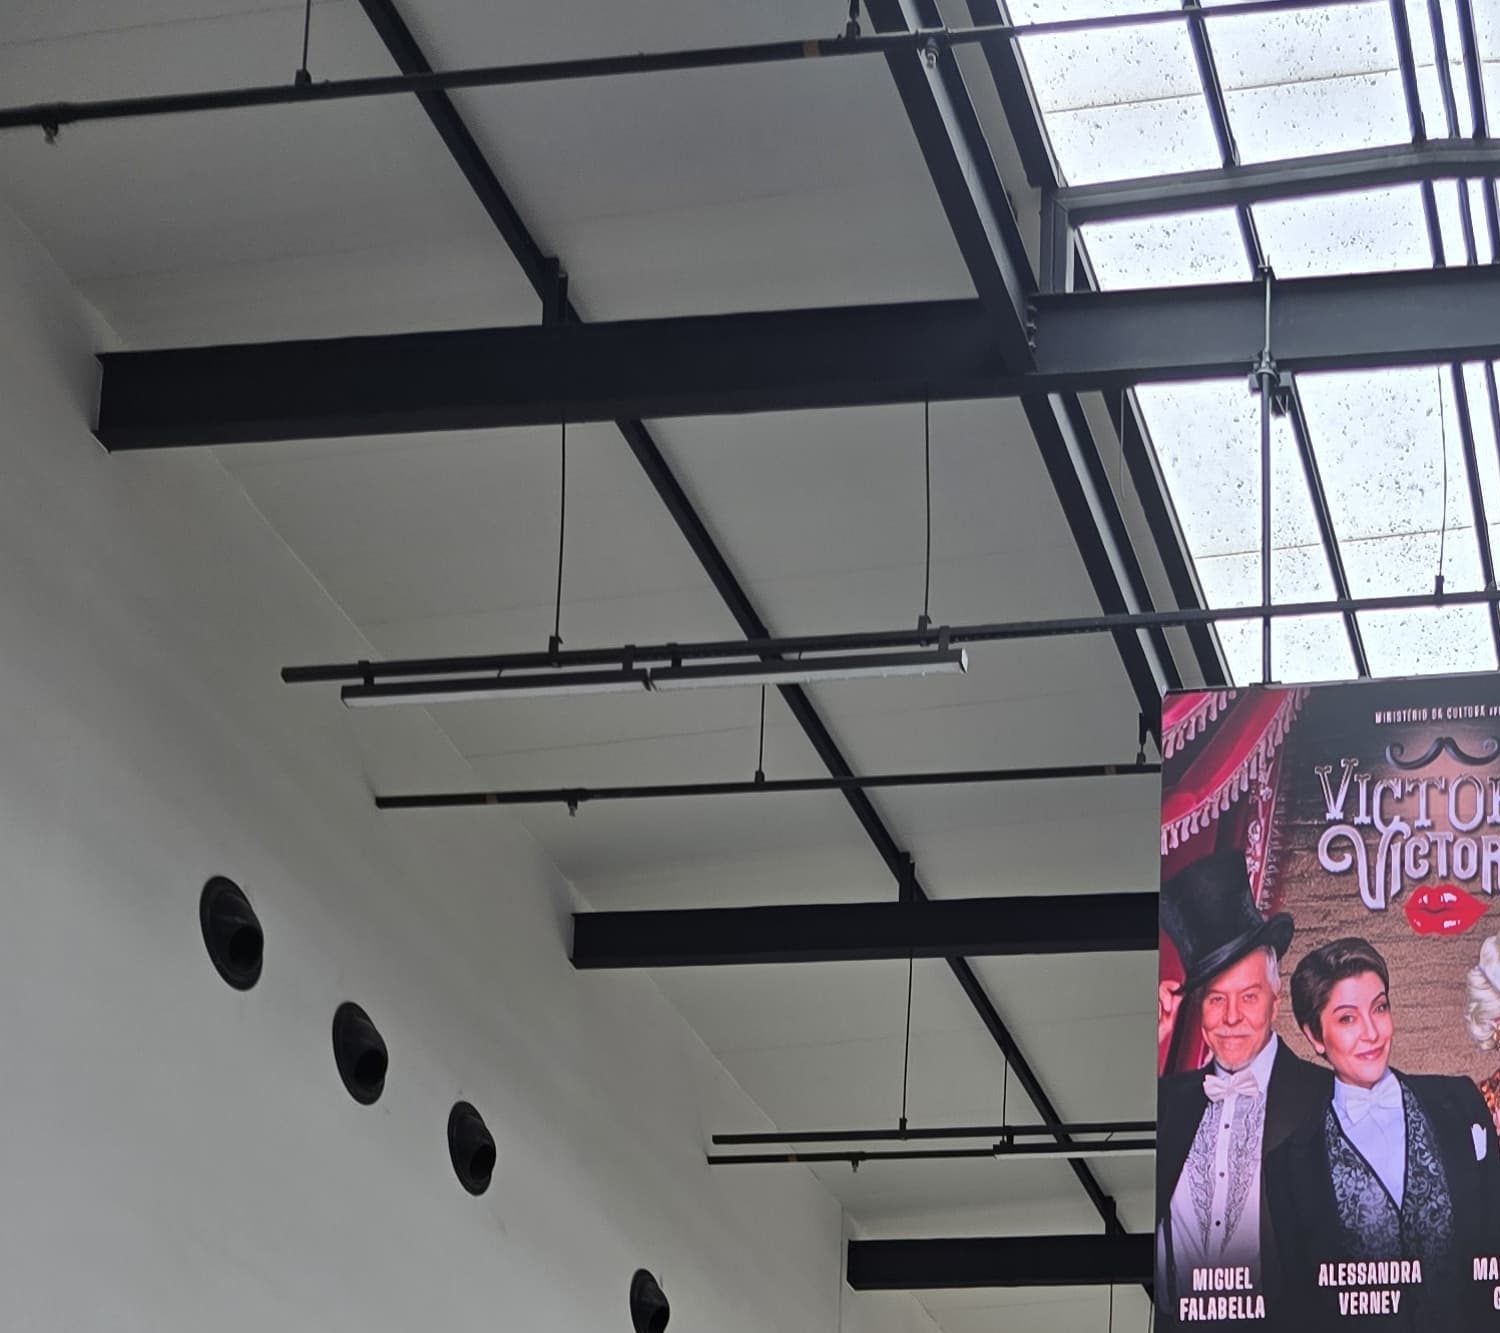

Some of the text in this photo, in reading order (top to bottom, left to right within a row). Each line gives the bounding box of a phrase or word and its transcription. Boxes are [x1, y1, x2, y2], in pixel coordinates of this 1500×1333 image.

[1192, 1267, 1253, 1291] MIGUEL
[1318, 1260, 1422, 1287] ALESSANDRA
[1179, 1295, 1266, 1321] FALABELLA
[1338, 1290, 1401, 1316] VERNEY
